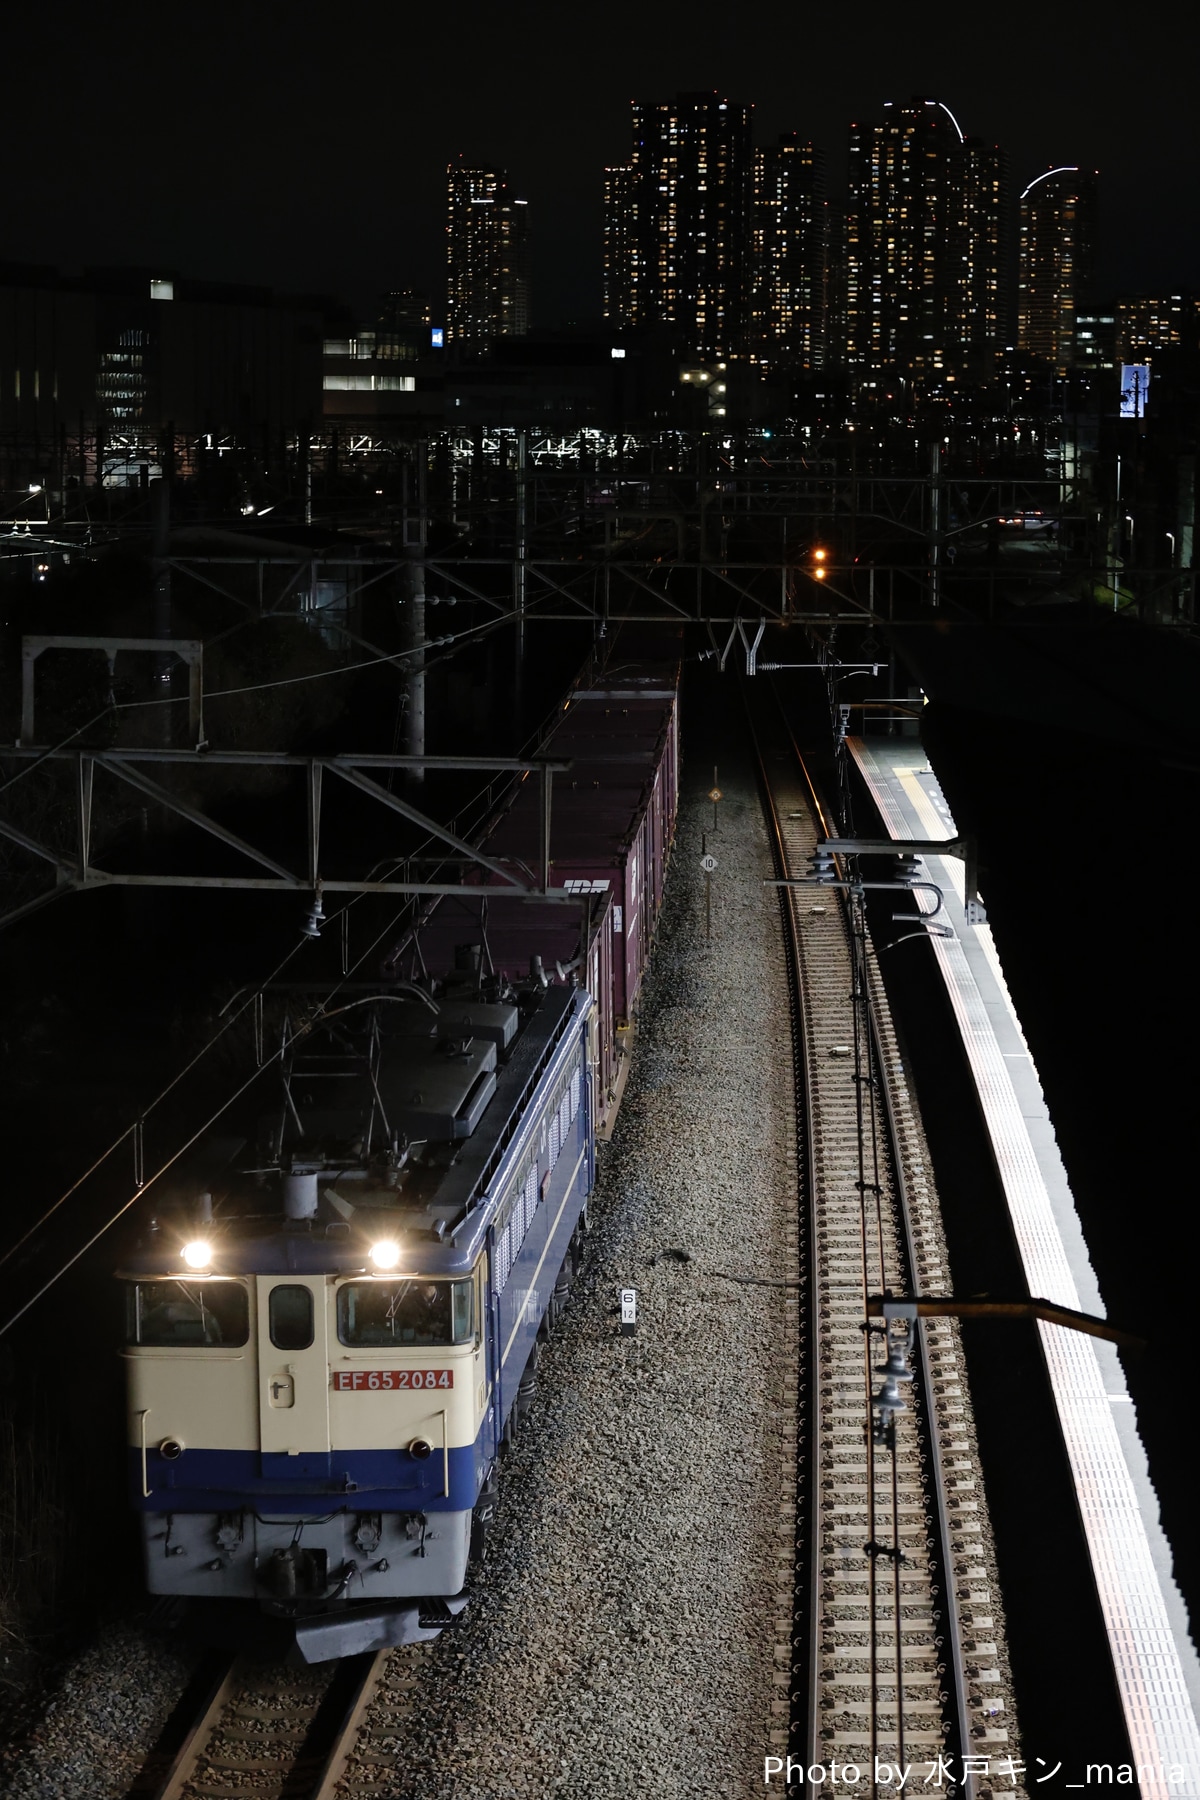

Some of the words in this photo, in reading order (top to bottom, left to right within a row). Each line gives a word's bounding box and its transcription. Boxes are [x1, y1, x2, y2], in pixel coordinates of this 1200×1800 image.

[705, 859, 714, 868] 10
[623, 1293, 634, 1303] 6
[623, 1310, 634, 1319] 12
[338, 1372, 394, 1390] EF65
[398, 1371, 450, 1389] 2084
